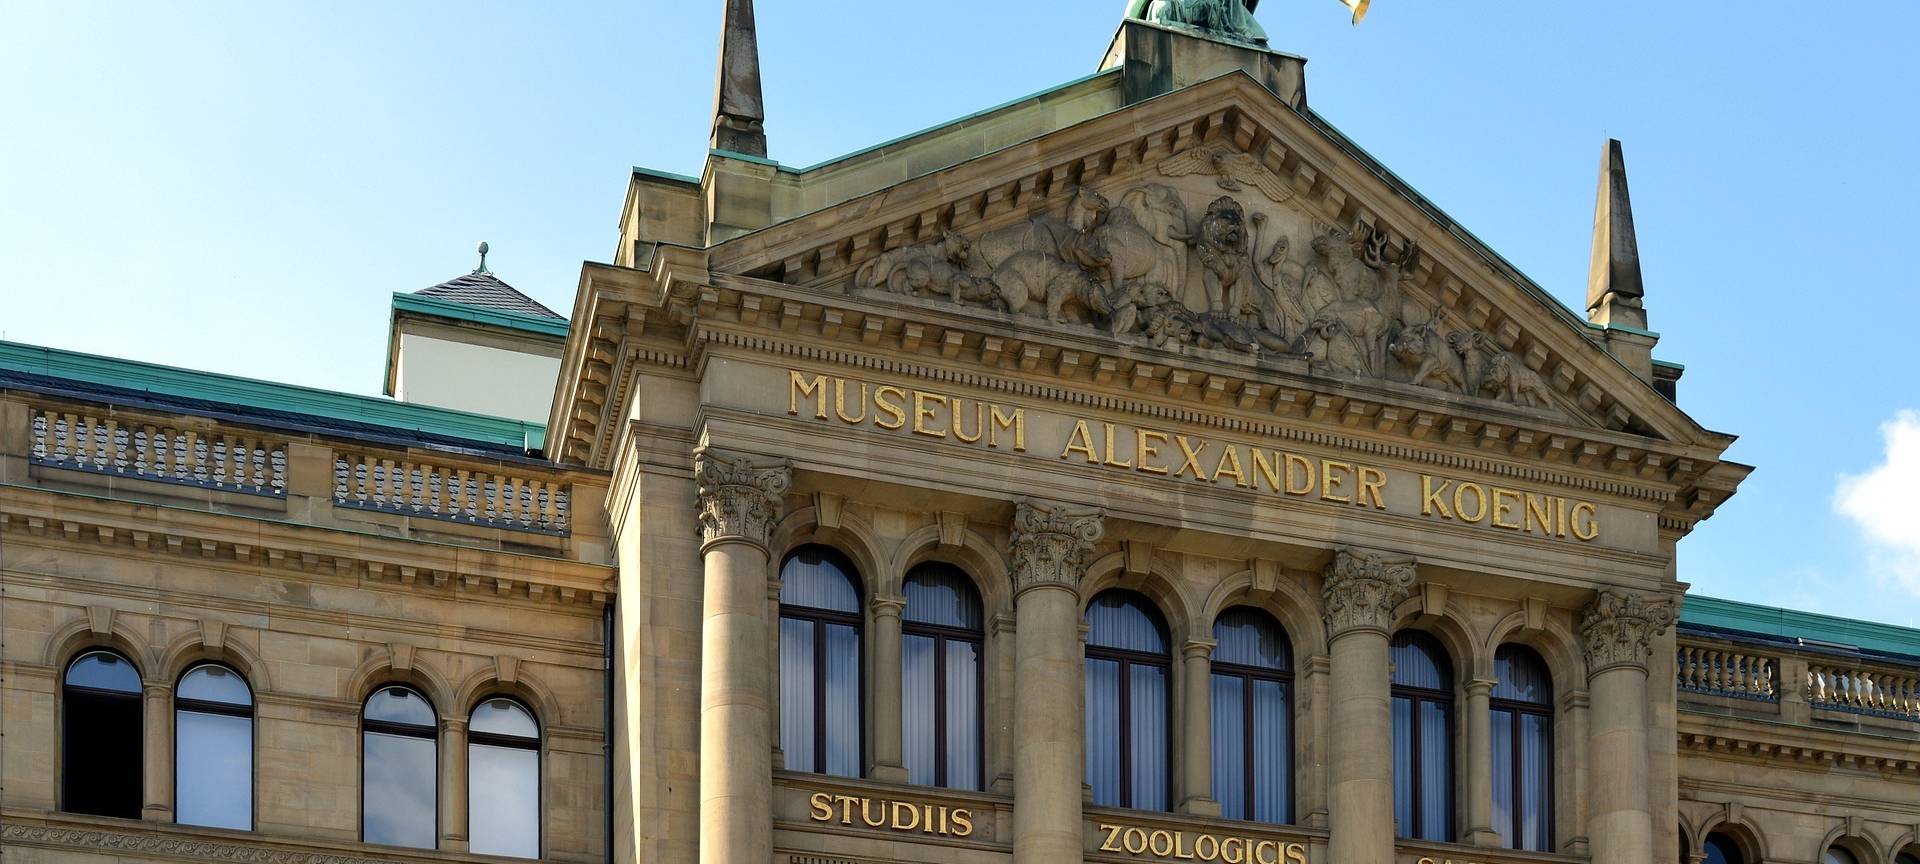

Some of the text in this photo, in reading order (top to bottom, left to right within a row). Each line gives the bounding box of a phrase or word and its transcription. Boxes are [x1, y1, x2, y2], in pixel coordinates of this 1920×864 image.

[787, 370, 1599, 541] MUSEUM ALEXANDER KOENIG
[810, 792, 1306, 864] STUDIIS ZOOLOGICIS
